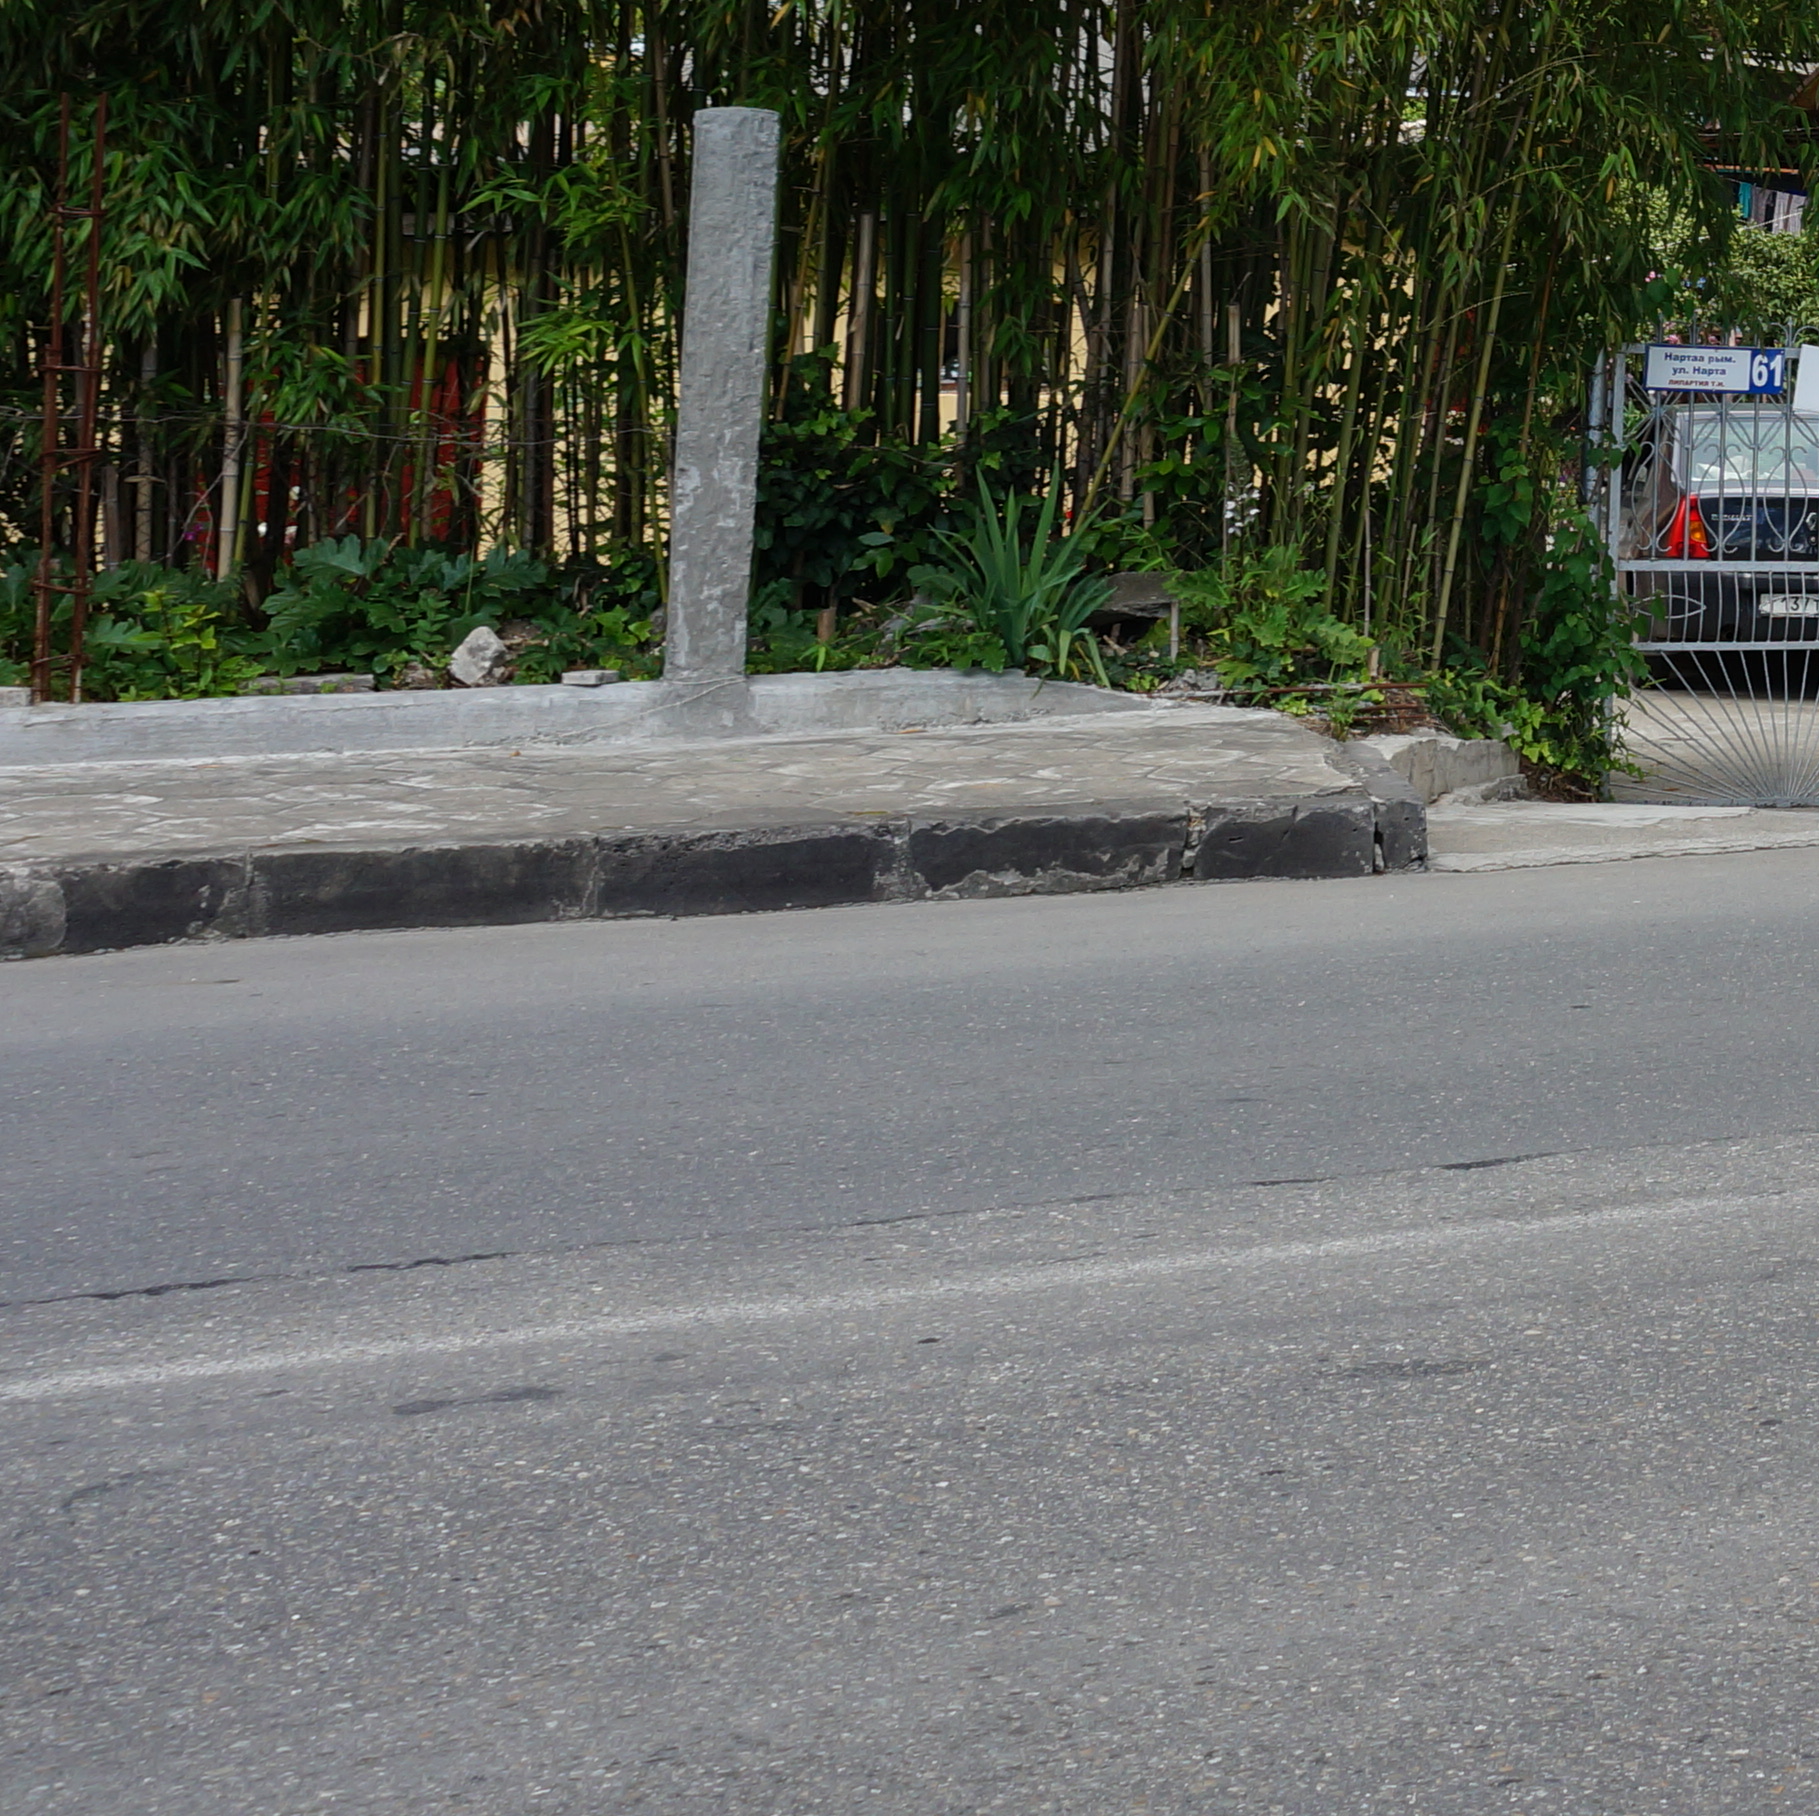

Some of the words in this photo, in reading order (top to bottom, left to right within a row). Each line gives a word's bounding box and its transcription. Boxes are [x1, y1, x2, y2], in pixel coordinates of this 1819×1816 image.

[1664, 352, 1704, 363] Нартаа
[1672, 367, 1689, 376] ул.
[1692, 366, 1726, 377] Нарта
[1752, 354, 1782, 387] 61
